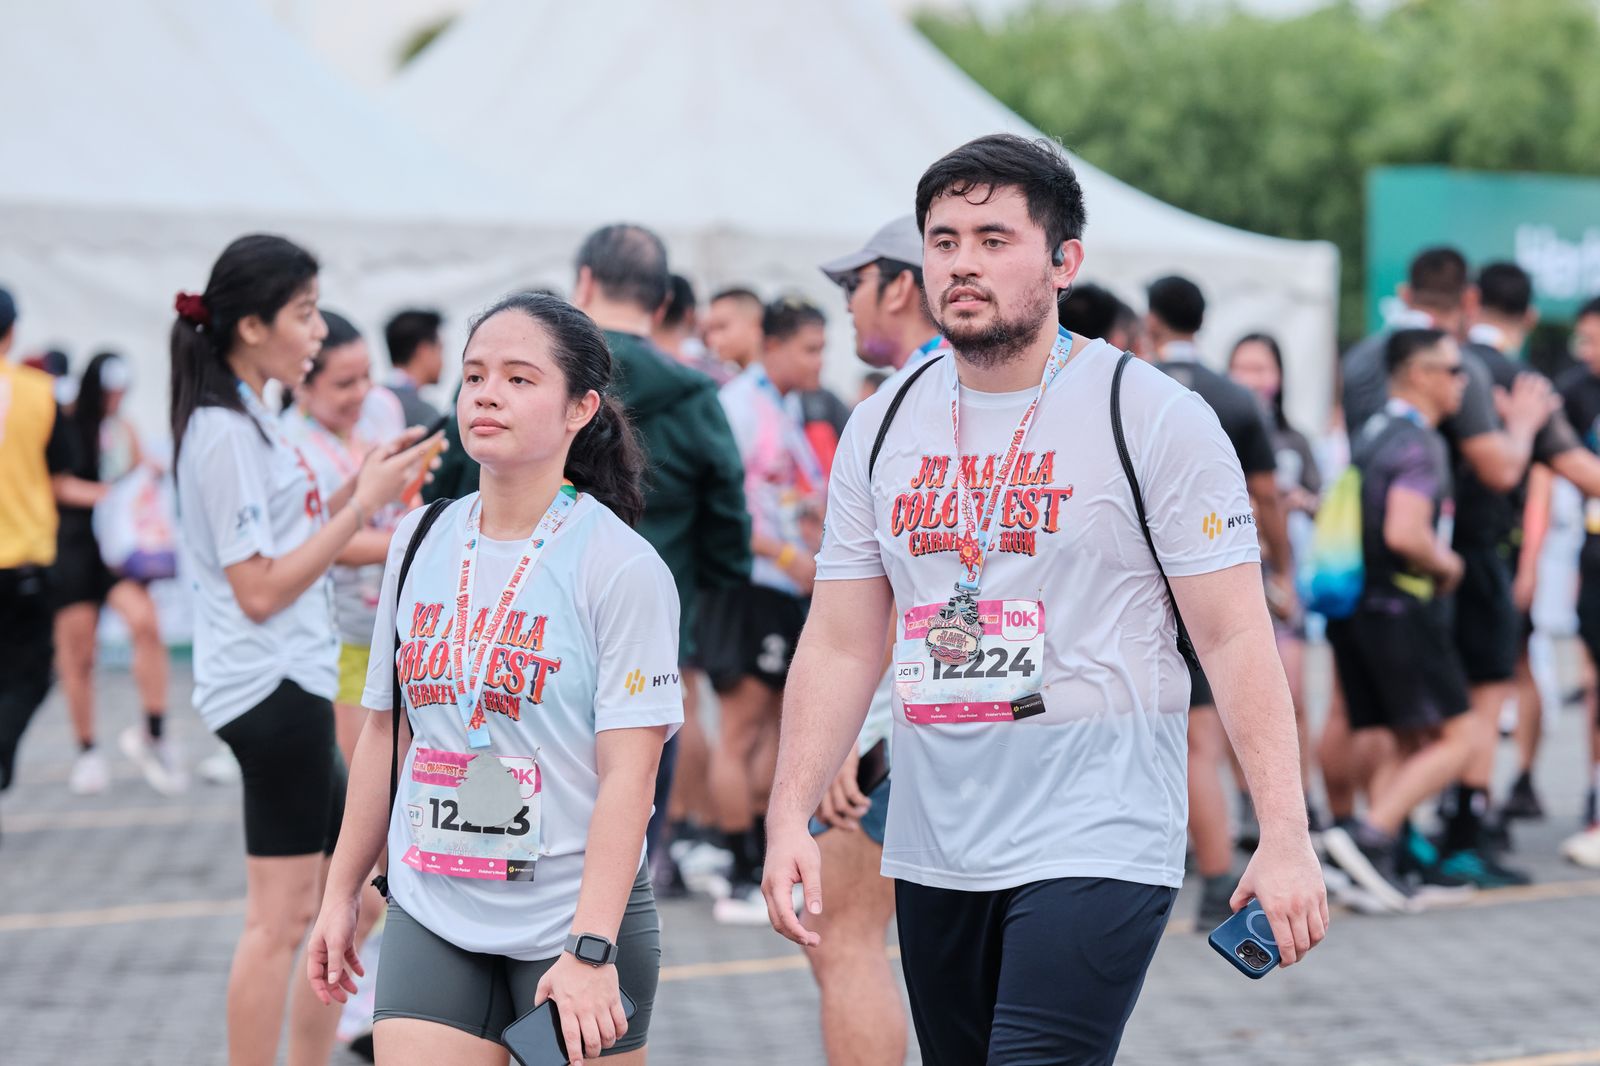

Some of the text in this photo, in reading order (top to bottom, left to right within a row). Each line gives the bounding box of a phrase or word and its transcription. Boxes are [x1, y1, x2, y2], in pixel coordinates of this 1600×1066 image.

[911, 449, 1057, 490] JCI MAILA
[891, 484, 1074, 537] COLOREST
[999, 530, 1037, 557] RUN
[1004, 611, 1037, 627] 10K
[898, 668, 911, 676] JCI
[484, 690, 521, 722] RUN
[429, 797, 531, 836] 123
